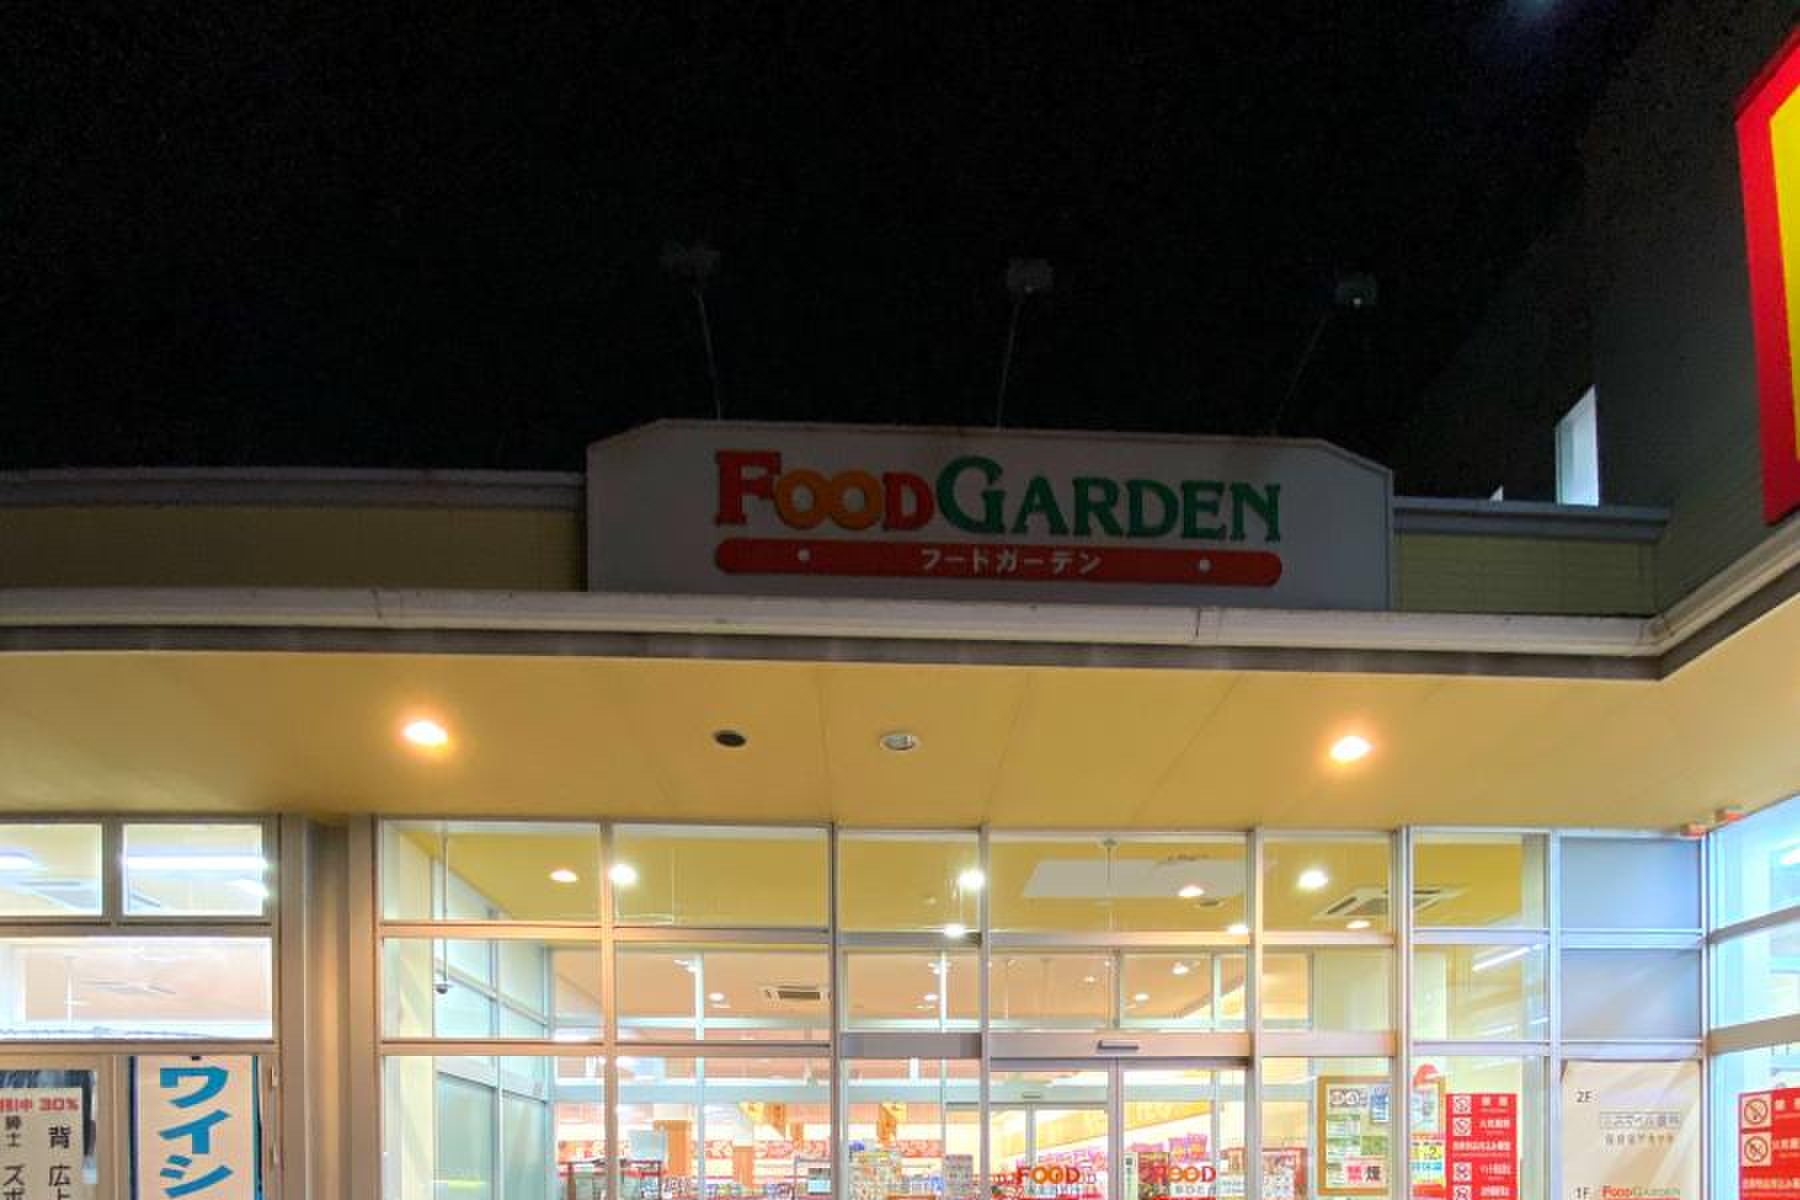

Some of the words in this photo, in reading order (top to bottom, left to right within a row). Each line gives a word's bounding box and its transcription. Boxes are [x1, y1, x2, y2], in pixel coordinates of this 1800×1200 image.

[921, 546, 1103, 574] フードガーデン
[1577, 1091, 1592, 1103] 2F
[1576, 1187, 1591, 1199] 1F
